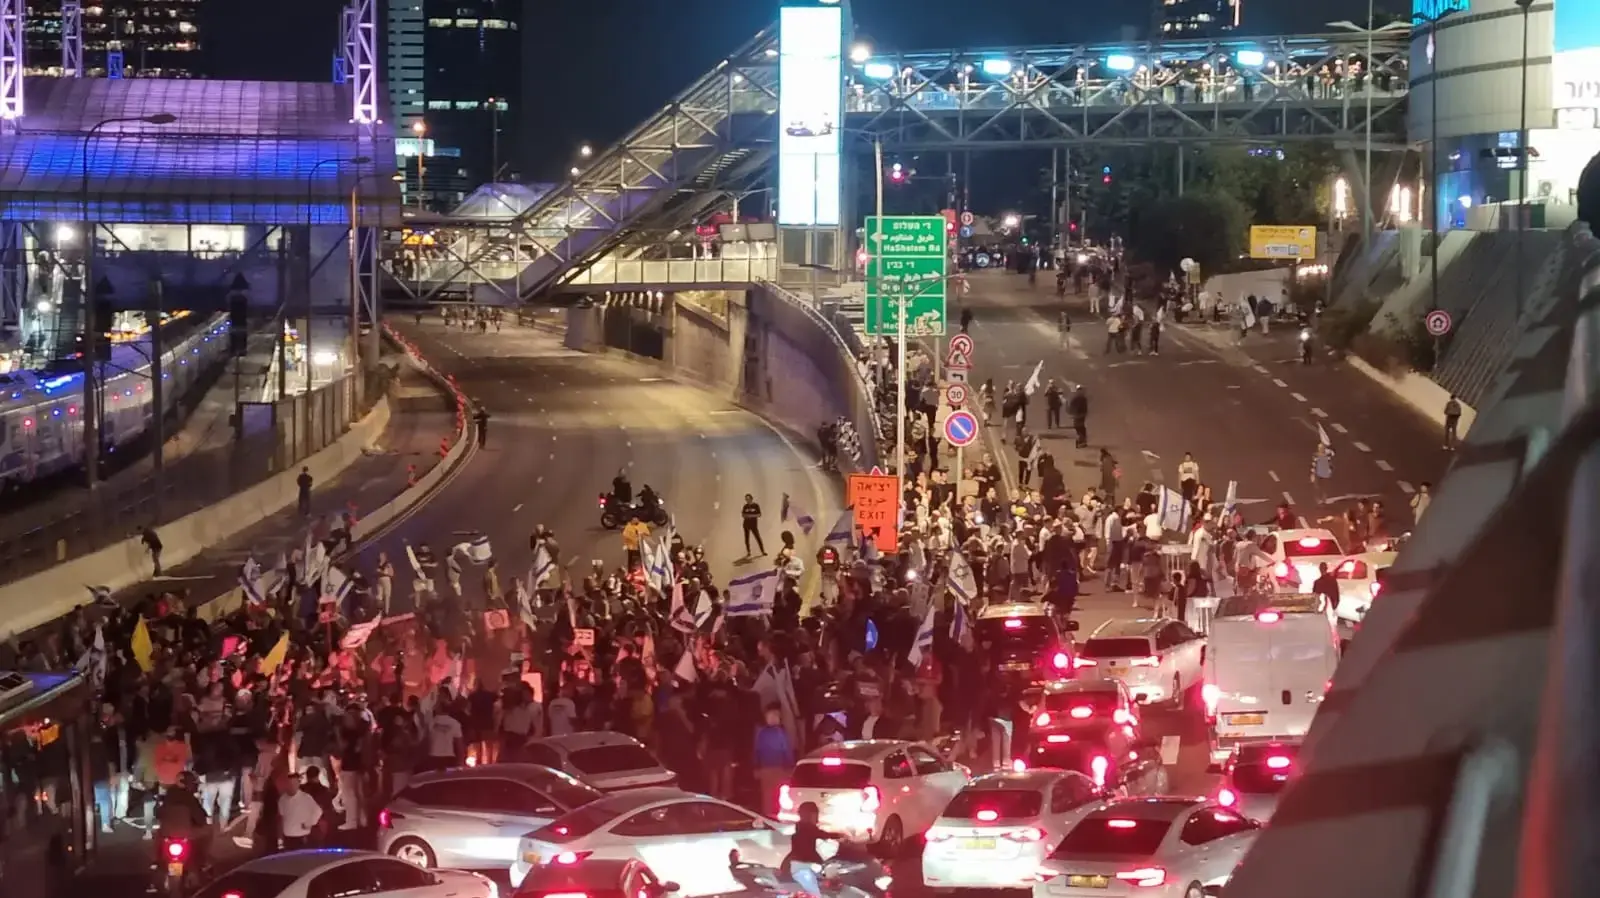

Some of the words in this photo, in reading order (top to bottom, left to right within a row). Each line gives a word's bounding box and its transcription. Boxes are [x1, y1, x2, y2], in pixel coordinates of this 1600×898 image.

[893, 221, 920, 230] השלום
[951, 391, 962, 399] 30
[857, 482, 890, 492] יציאה
[859, 511, 885, 519] EXIT
